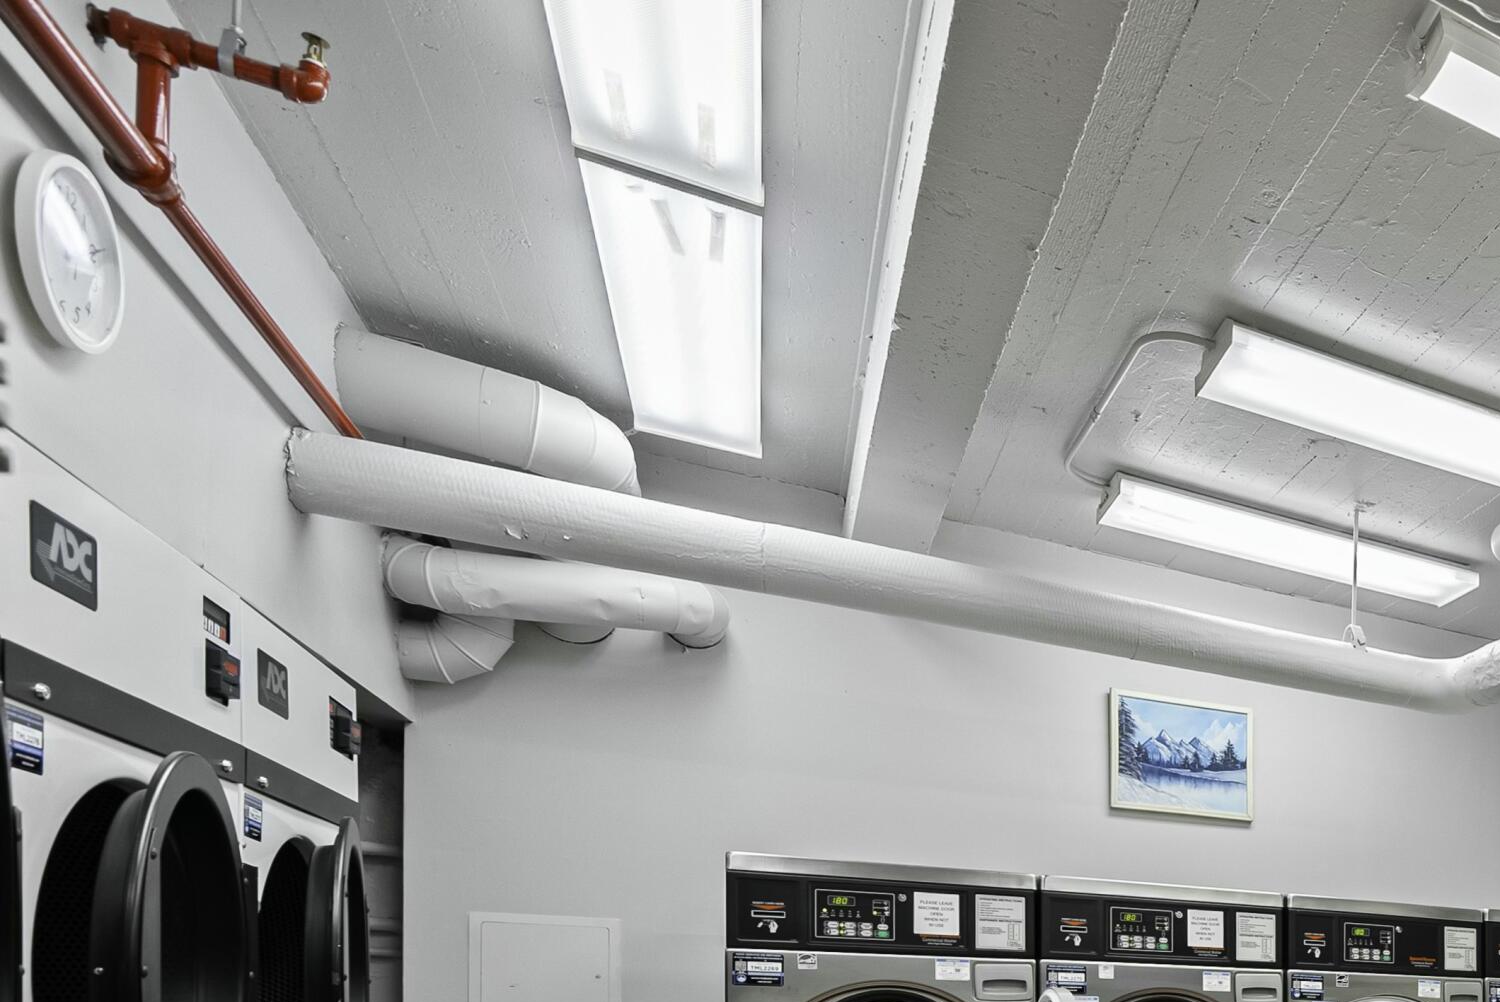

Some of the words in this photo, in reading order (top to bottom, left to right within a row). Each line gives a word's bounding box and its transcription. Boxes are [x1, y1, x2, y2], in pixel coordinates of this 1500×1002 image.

[49, 521, 92, 583] ADC
[266, 661, 287, 699] ADC
[832, 896, 848, 905] 180
